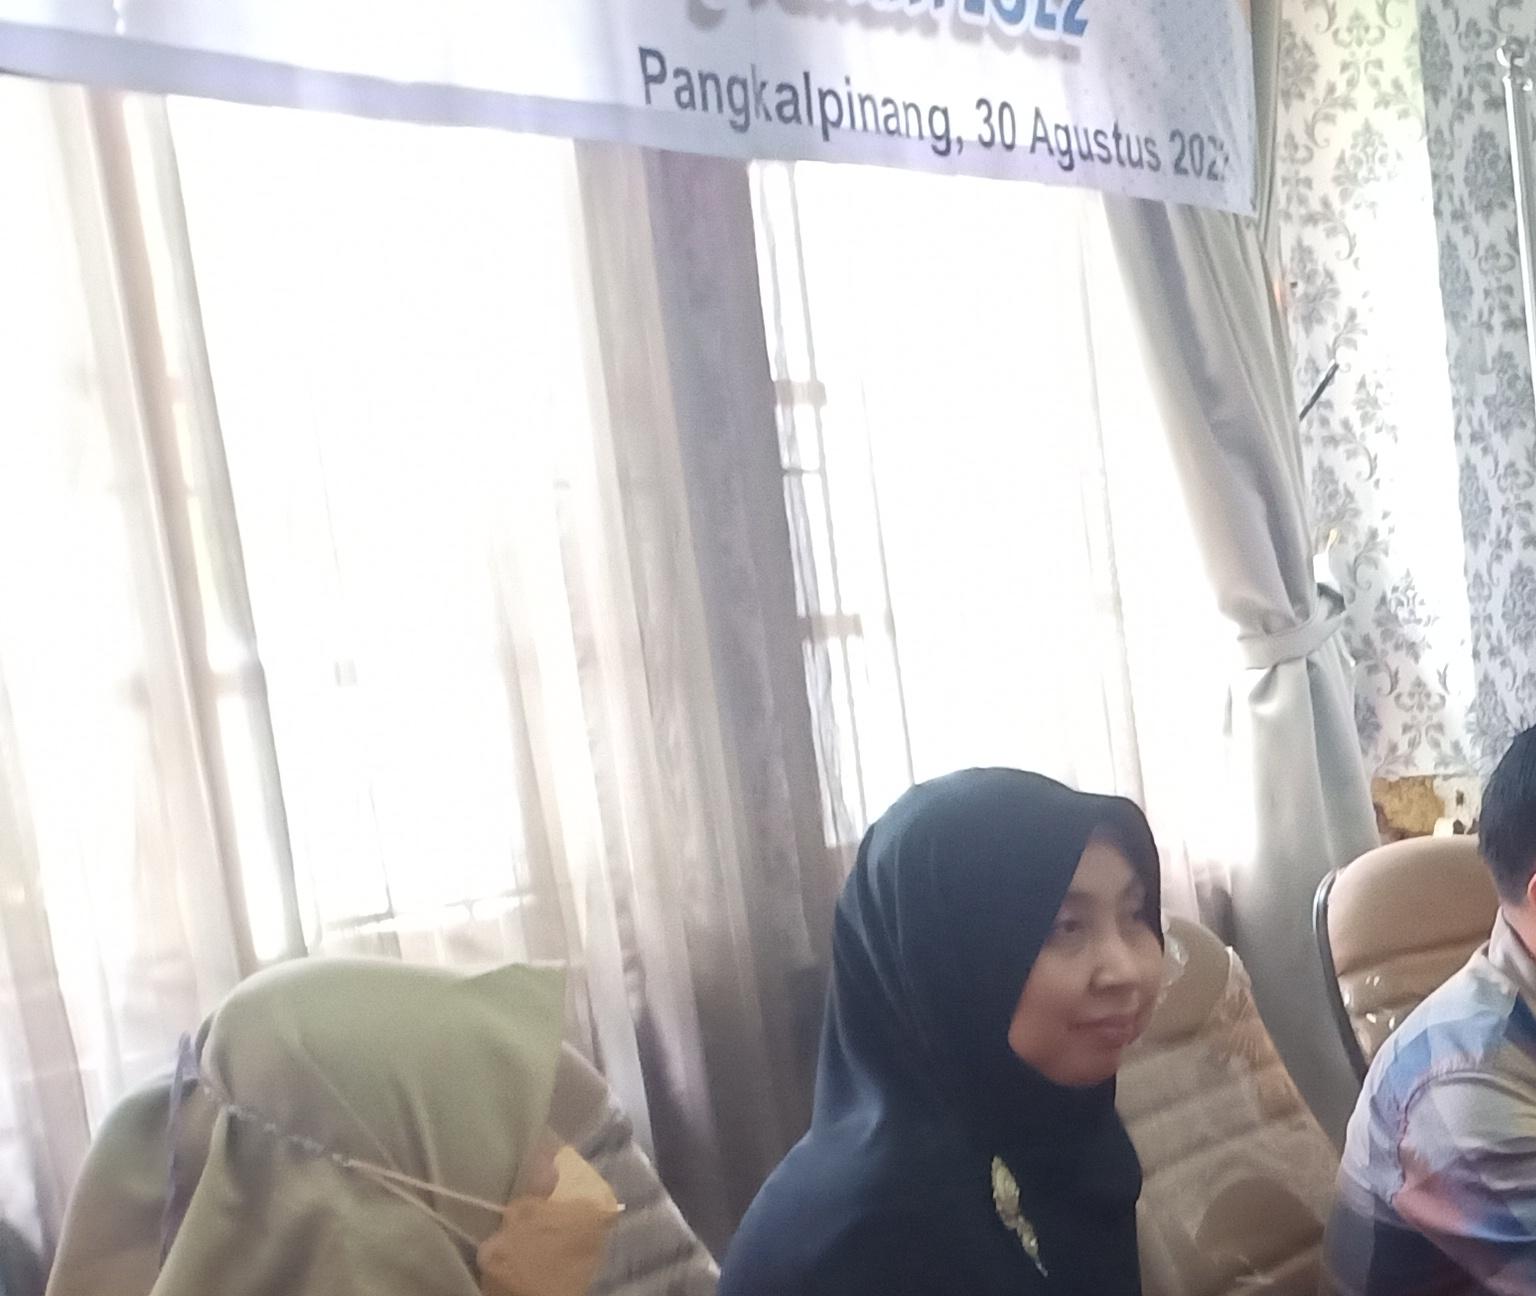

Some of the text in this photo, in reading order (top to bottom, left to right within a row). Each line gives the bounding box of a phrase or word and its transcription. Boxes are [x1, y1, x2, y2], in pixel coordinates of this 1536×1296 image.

[637, 45, 964, 157] Pangkalpinang,
[973, 97, 1017, 151] 30
[1029, 106, 1162, 172] Agustus
